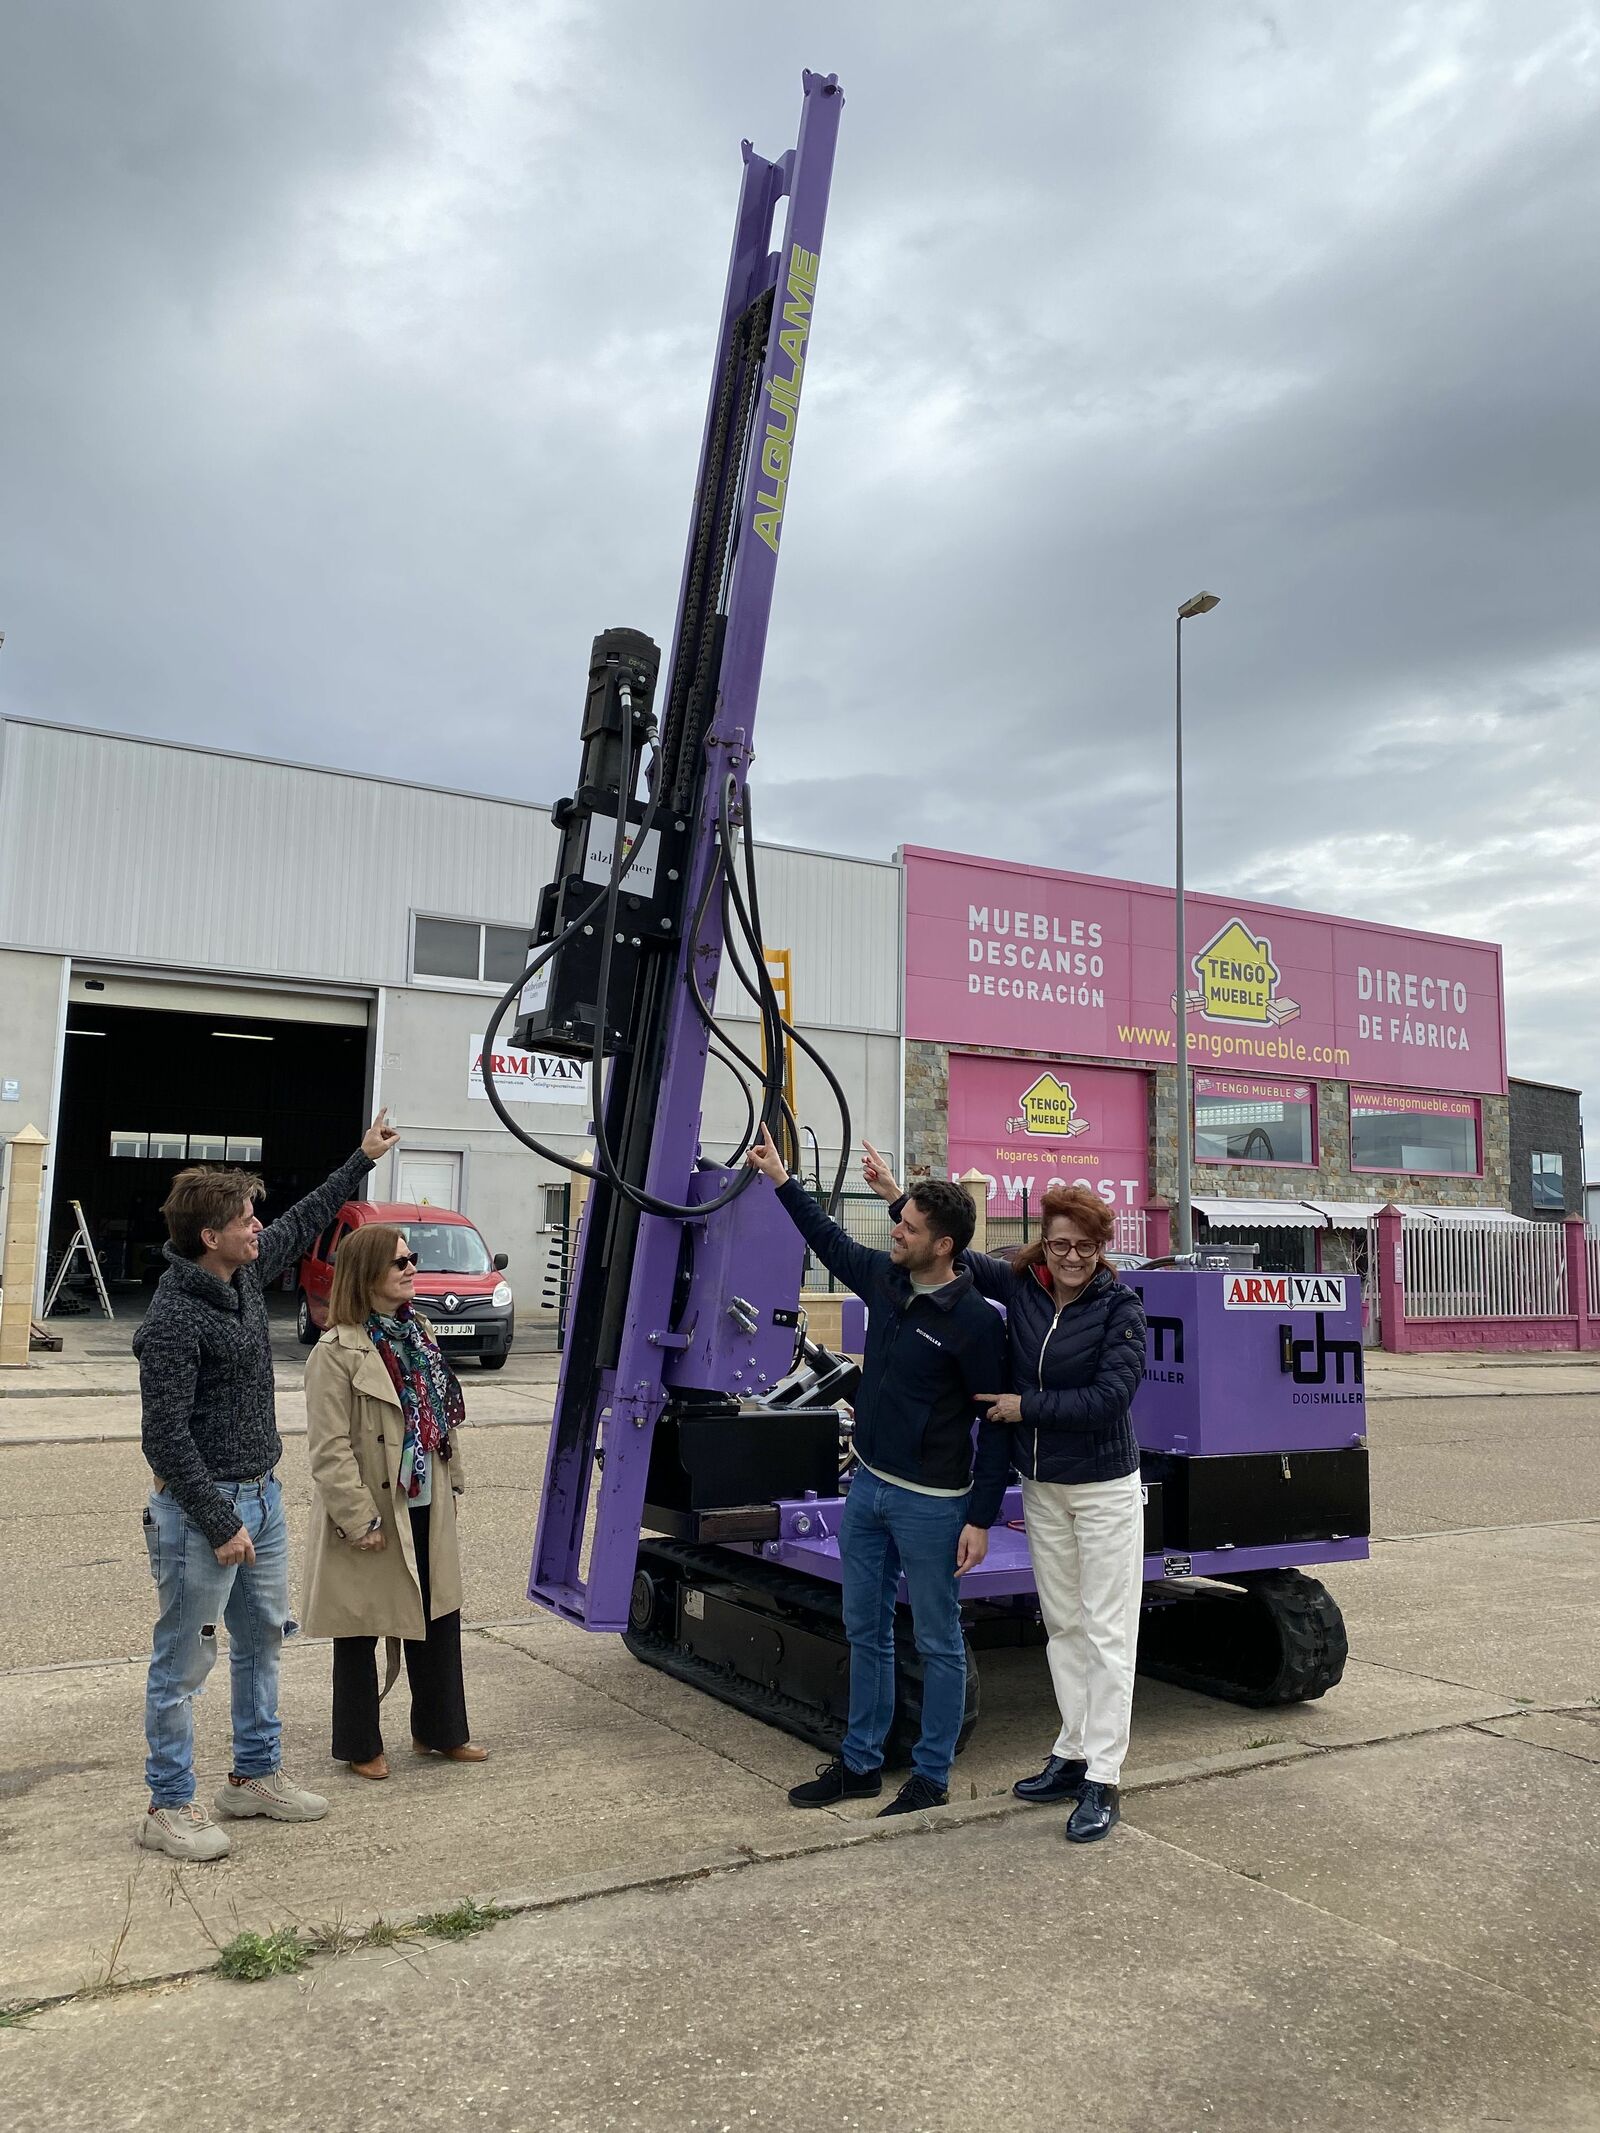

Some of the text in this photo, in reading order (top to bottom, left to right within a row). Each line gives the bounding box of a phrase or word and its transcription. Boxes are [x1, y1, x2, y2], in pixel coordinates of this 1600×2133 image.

[753, 243, 819, 554] ALQUÍLAME
[968, 904, 1103, 948] MUEBLES
[968, 938, 1104, 978] DESCANSO
[1208, 958, 1266, 984] TENGO
[968, 973, 1104, 1008] DECORACIÓN
[1210, 986, 1264, 1007] MUEBLE
[1358, 966, 1467, 1014] DIRECTO
[1359, 1013, 1470, 1051] DE FÁBRICA
[1117, 1025, 1350, 1066] www.engomueble.com
[1215, 1081, 1291, 1098] TENGO MUEBLE
[1029, 1097, 1067, 1111] TENGO
[1353, 1092, 1471, 1115] www.tengomueble.com
[1031, 1114, 1066, 1125] MUEBLE
[996, 1148, 1099, 1165] Hogares con encanto
[433, 1325, 473, 1335] 2191 JJN
